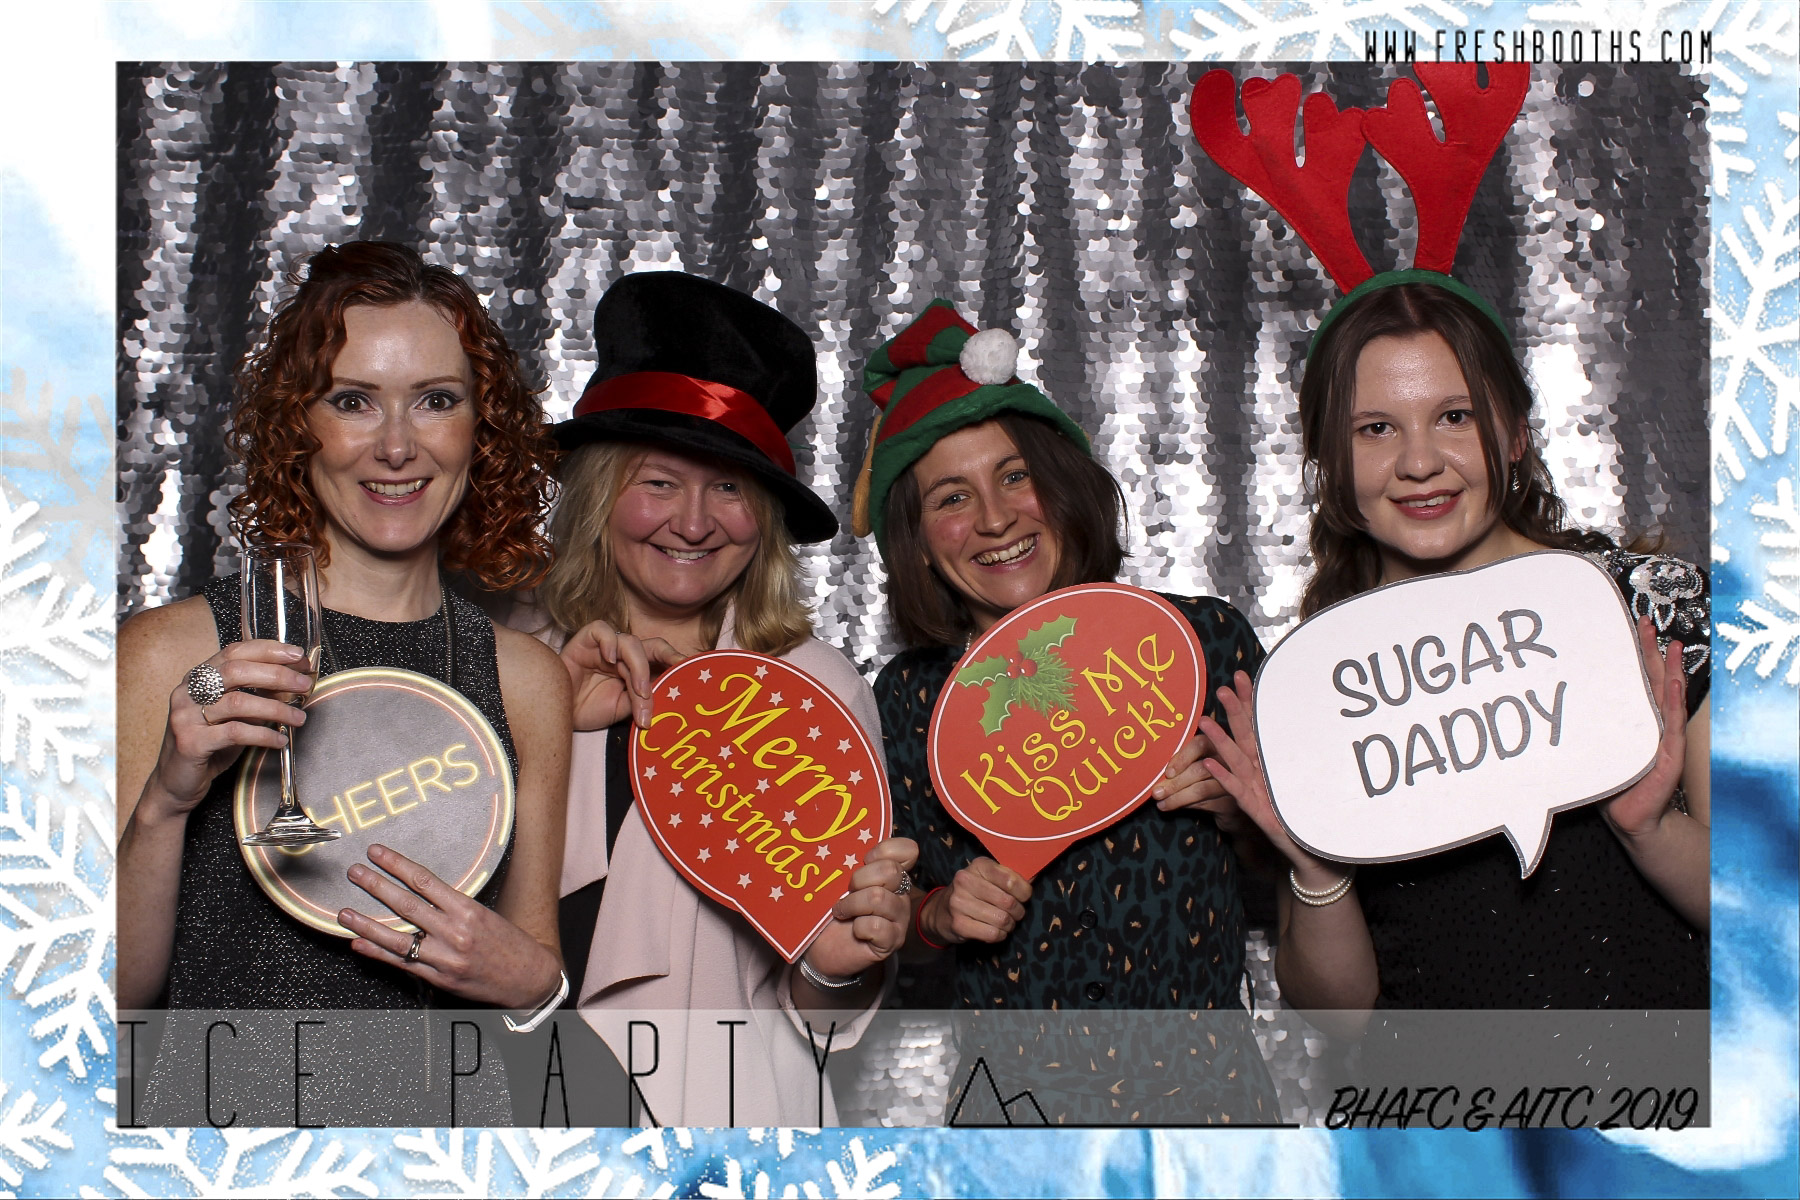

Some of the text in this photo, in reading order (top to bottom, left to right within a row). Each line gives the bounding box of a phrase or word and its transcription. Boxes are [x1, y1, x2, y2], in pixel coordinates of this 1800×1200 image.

[960, 633, 1175, 814] Kiss Me
[1332, 608, 1557, 718] SUGAR
[277, 743, 479, 856] HEERS
[639, 711, 843, 902] Christmas!
[695, 673, 868, 843] Merry
[1030, 682, 1184, 821] Quick!
[1352, 681, 1567, 798] DADDY
